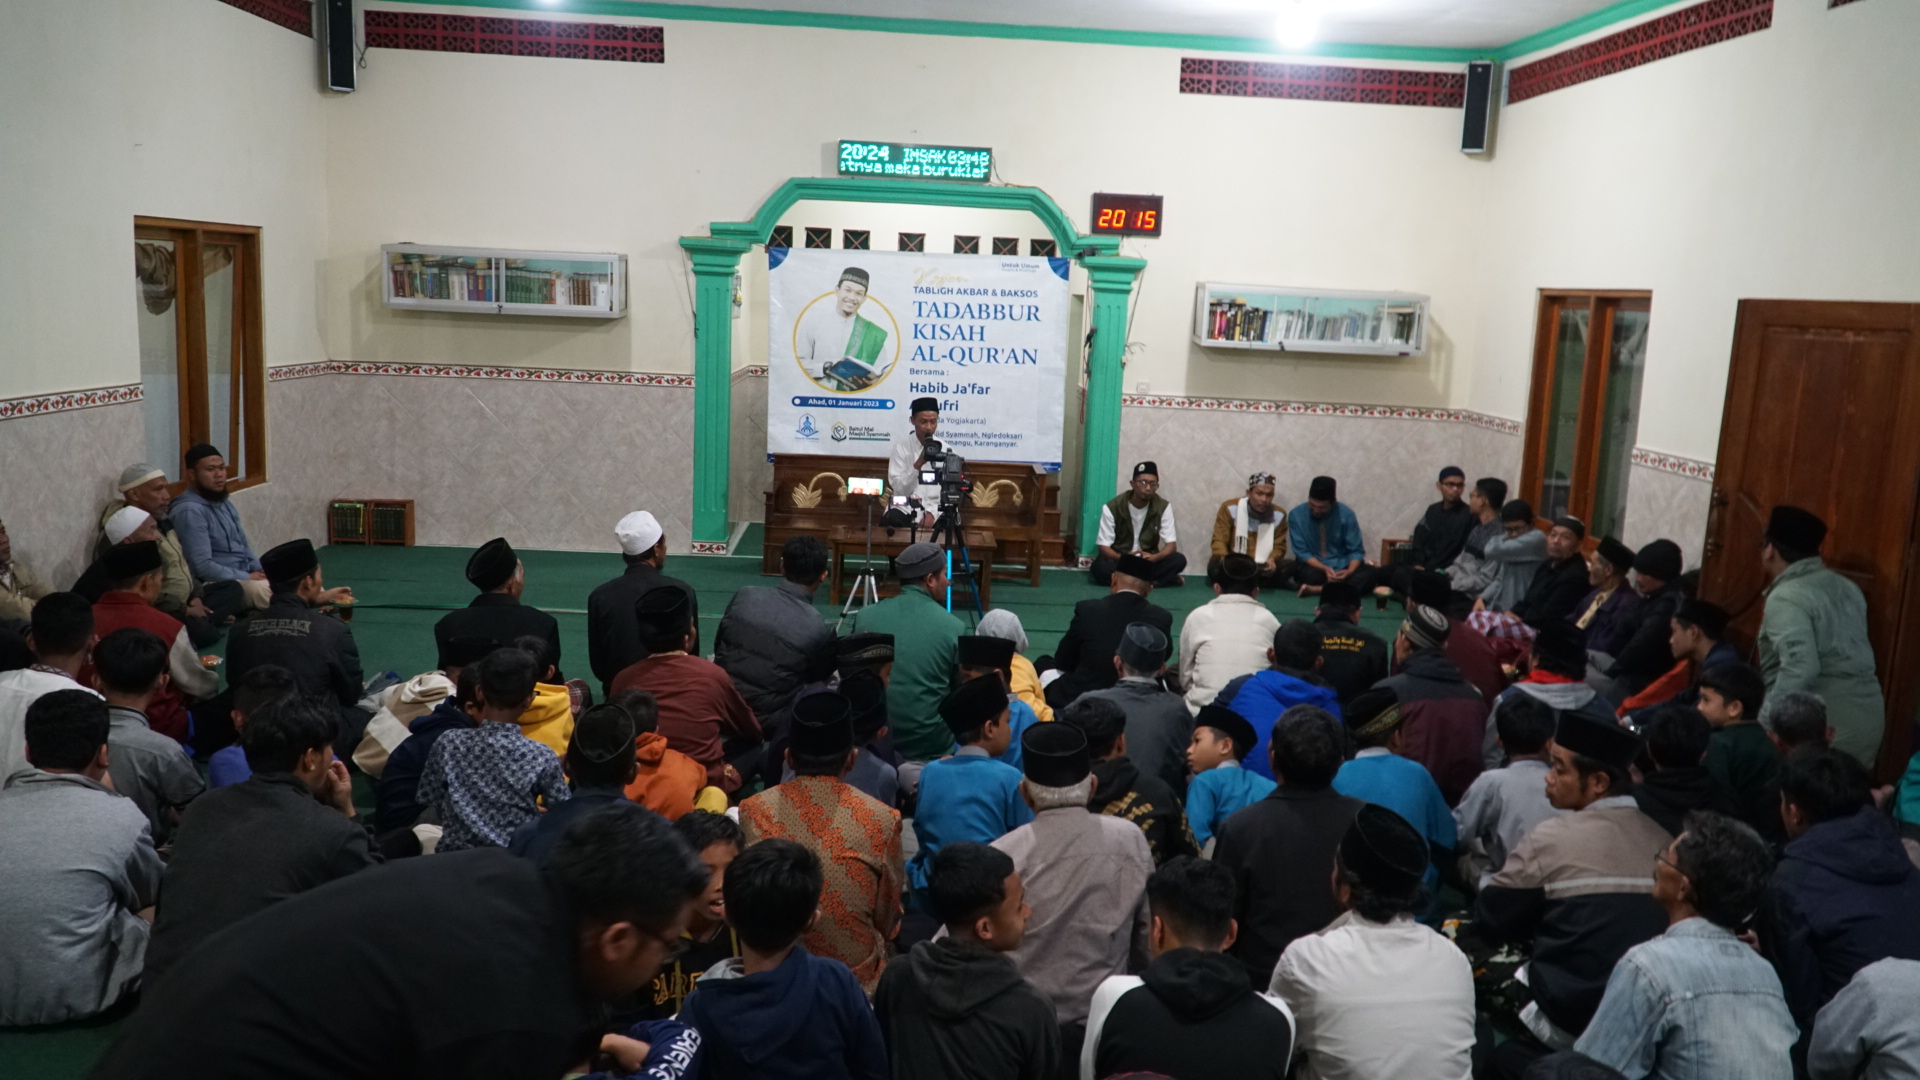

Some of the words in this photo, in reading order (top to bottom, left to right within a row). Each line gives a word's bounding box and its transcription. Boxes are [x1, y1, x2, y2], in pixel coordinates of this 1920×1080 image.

[885, 162, 920, 175] maka
[1098, 208, 1126, 228] 20
[1136, 210, 1157, 229] 15
[955, 288, 989, 296] AKBAR
[1000, 289, 1039, 298] BAKSOS
[913, 301, 1042, 322] TADABBUR
[912, 323, 986, 342] KISAH
[911, 345, 1039, 367] AL-QUR'AN
[909, 368, 945, 376] Bersama
[909, 382, 949, 393] Habib
[952, 383, 991, 395] Ja'far
[946, 417, 987, 425] Yogjakarta)
[945, 431, 980, 439] Syammah,
[981, 432, 1023, 440] Ngledoksari
[974, 441, 1018, 449] Karanganyar.
